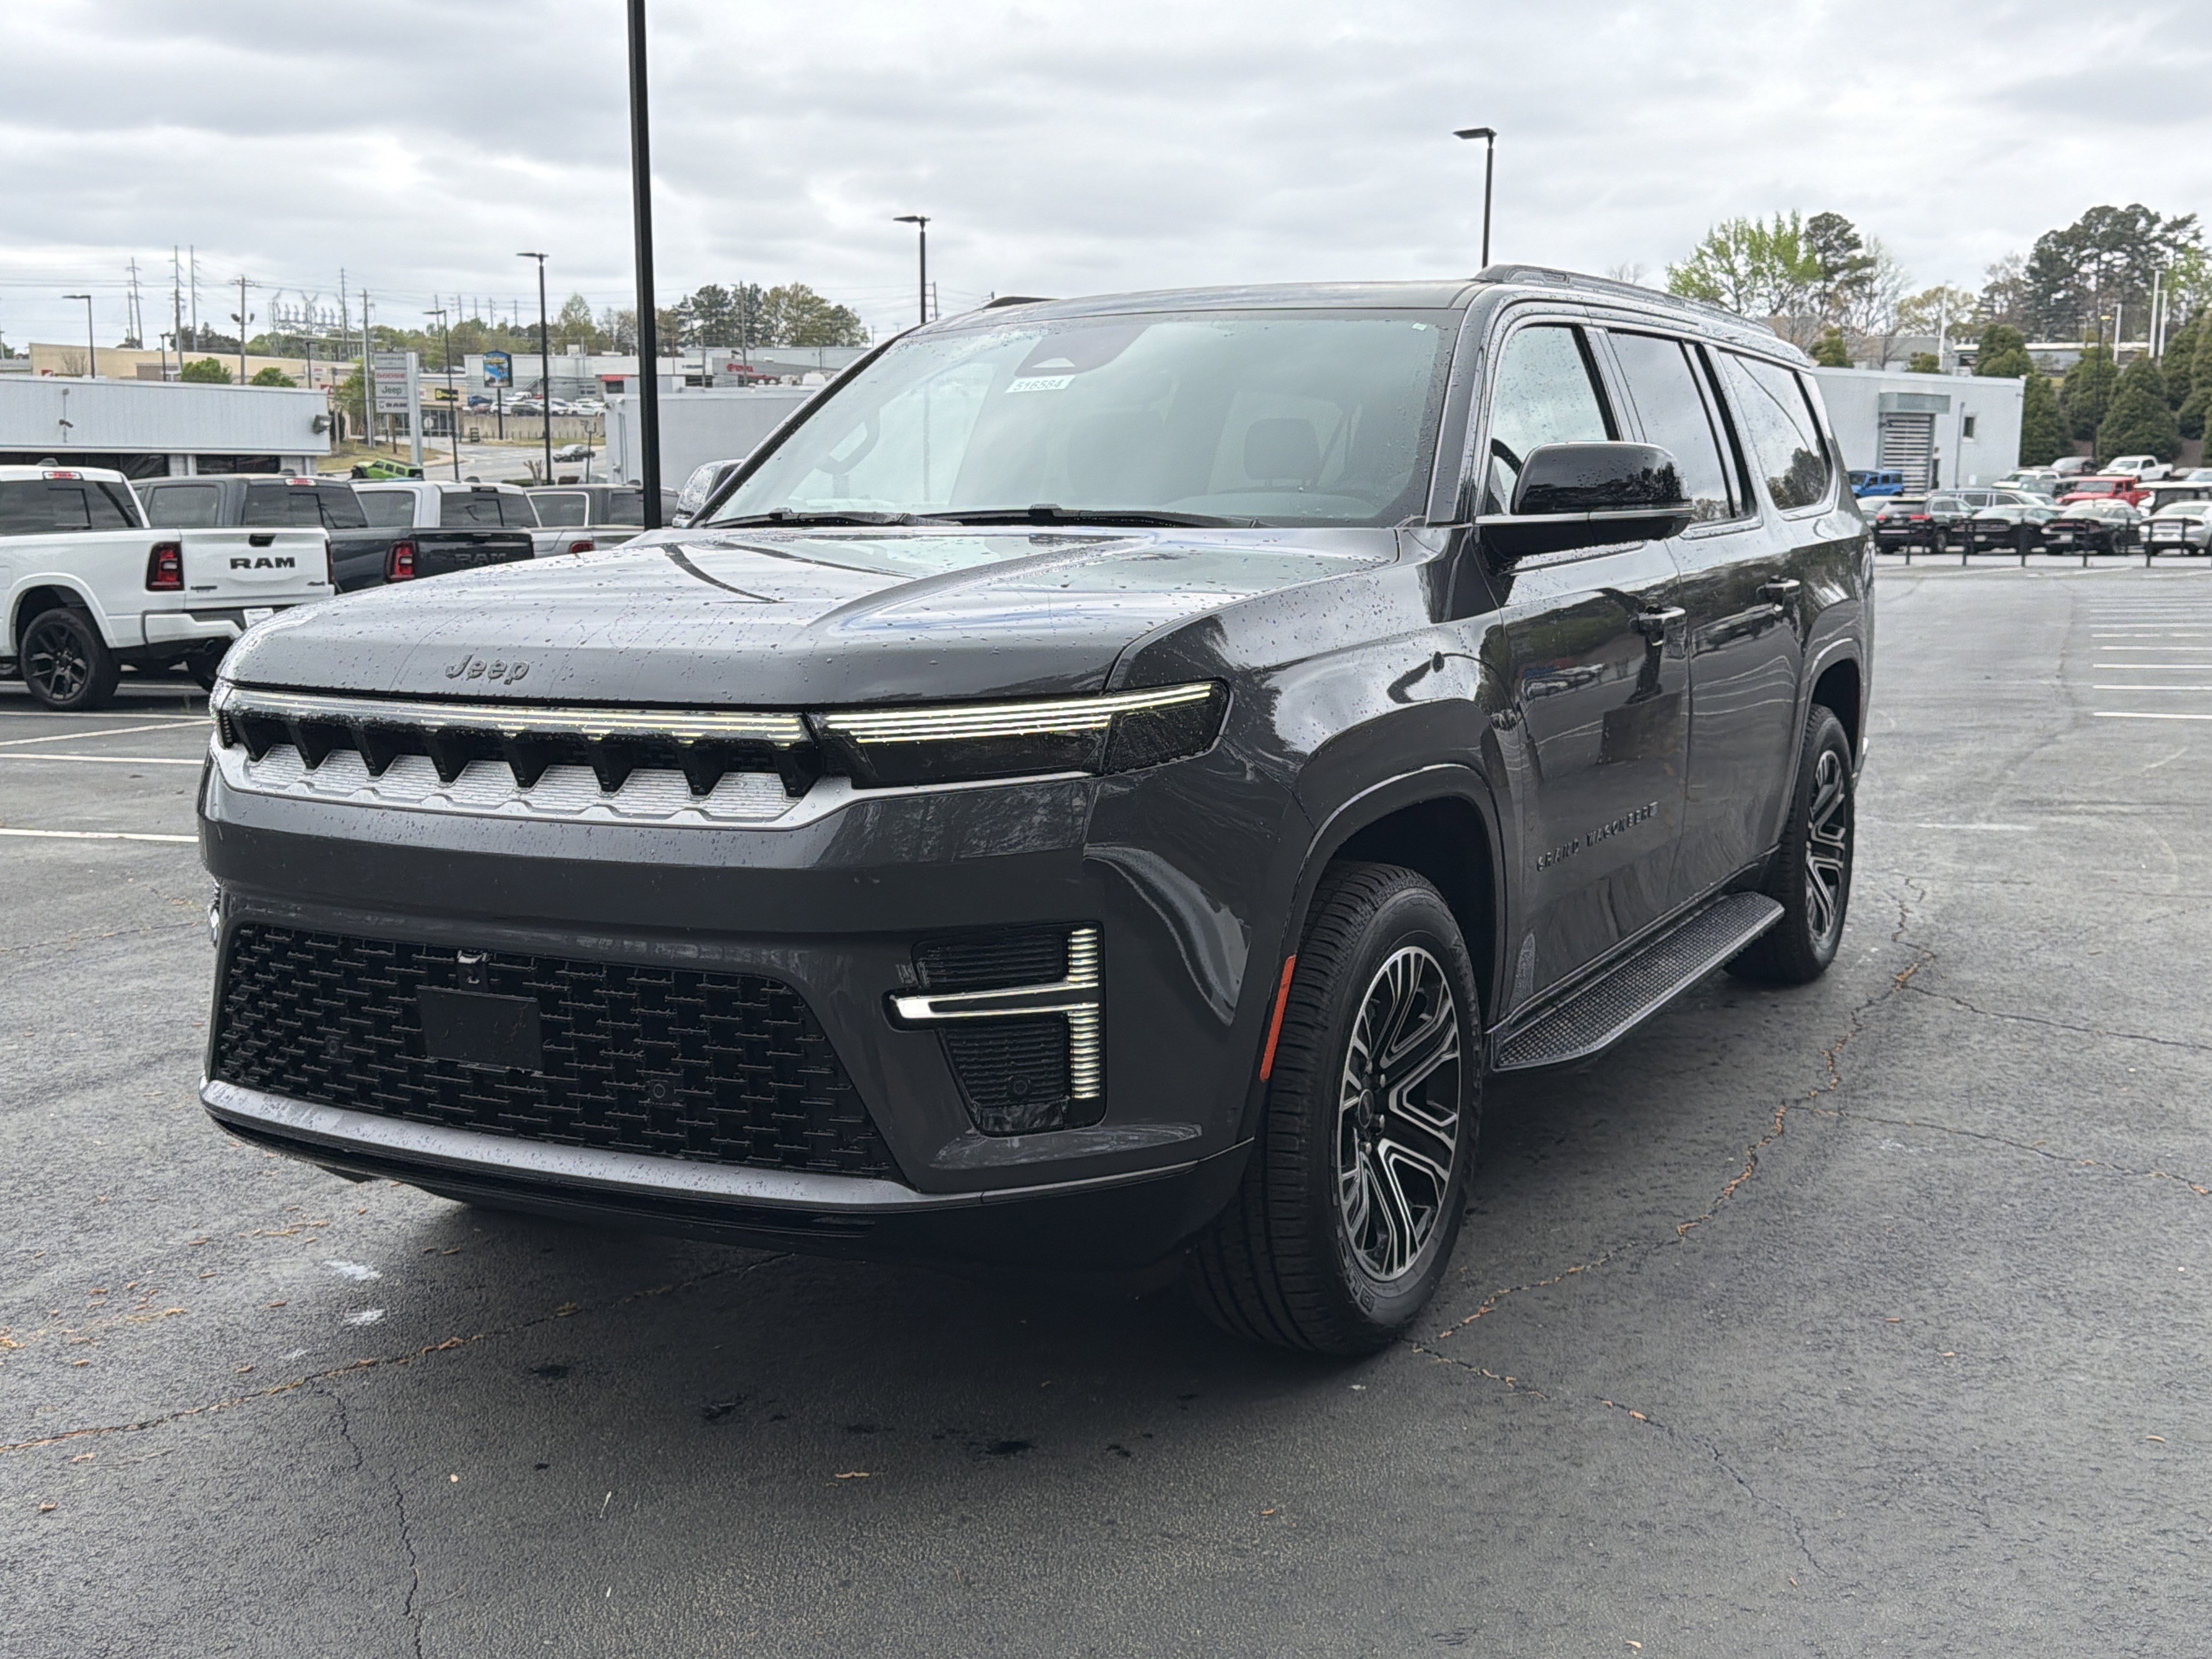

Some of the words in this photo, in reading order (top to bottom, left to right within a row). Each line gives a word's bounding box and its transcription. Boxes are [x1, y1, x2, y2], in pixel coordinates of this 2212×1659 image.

[381, 385, 402, 396] Jeep
[1013, 379, 1064, 391] 516584
[229, 557, 296, 569] RAM
[445, 653, 530, 685] Jeep
